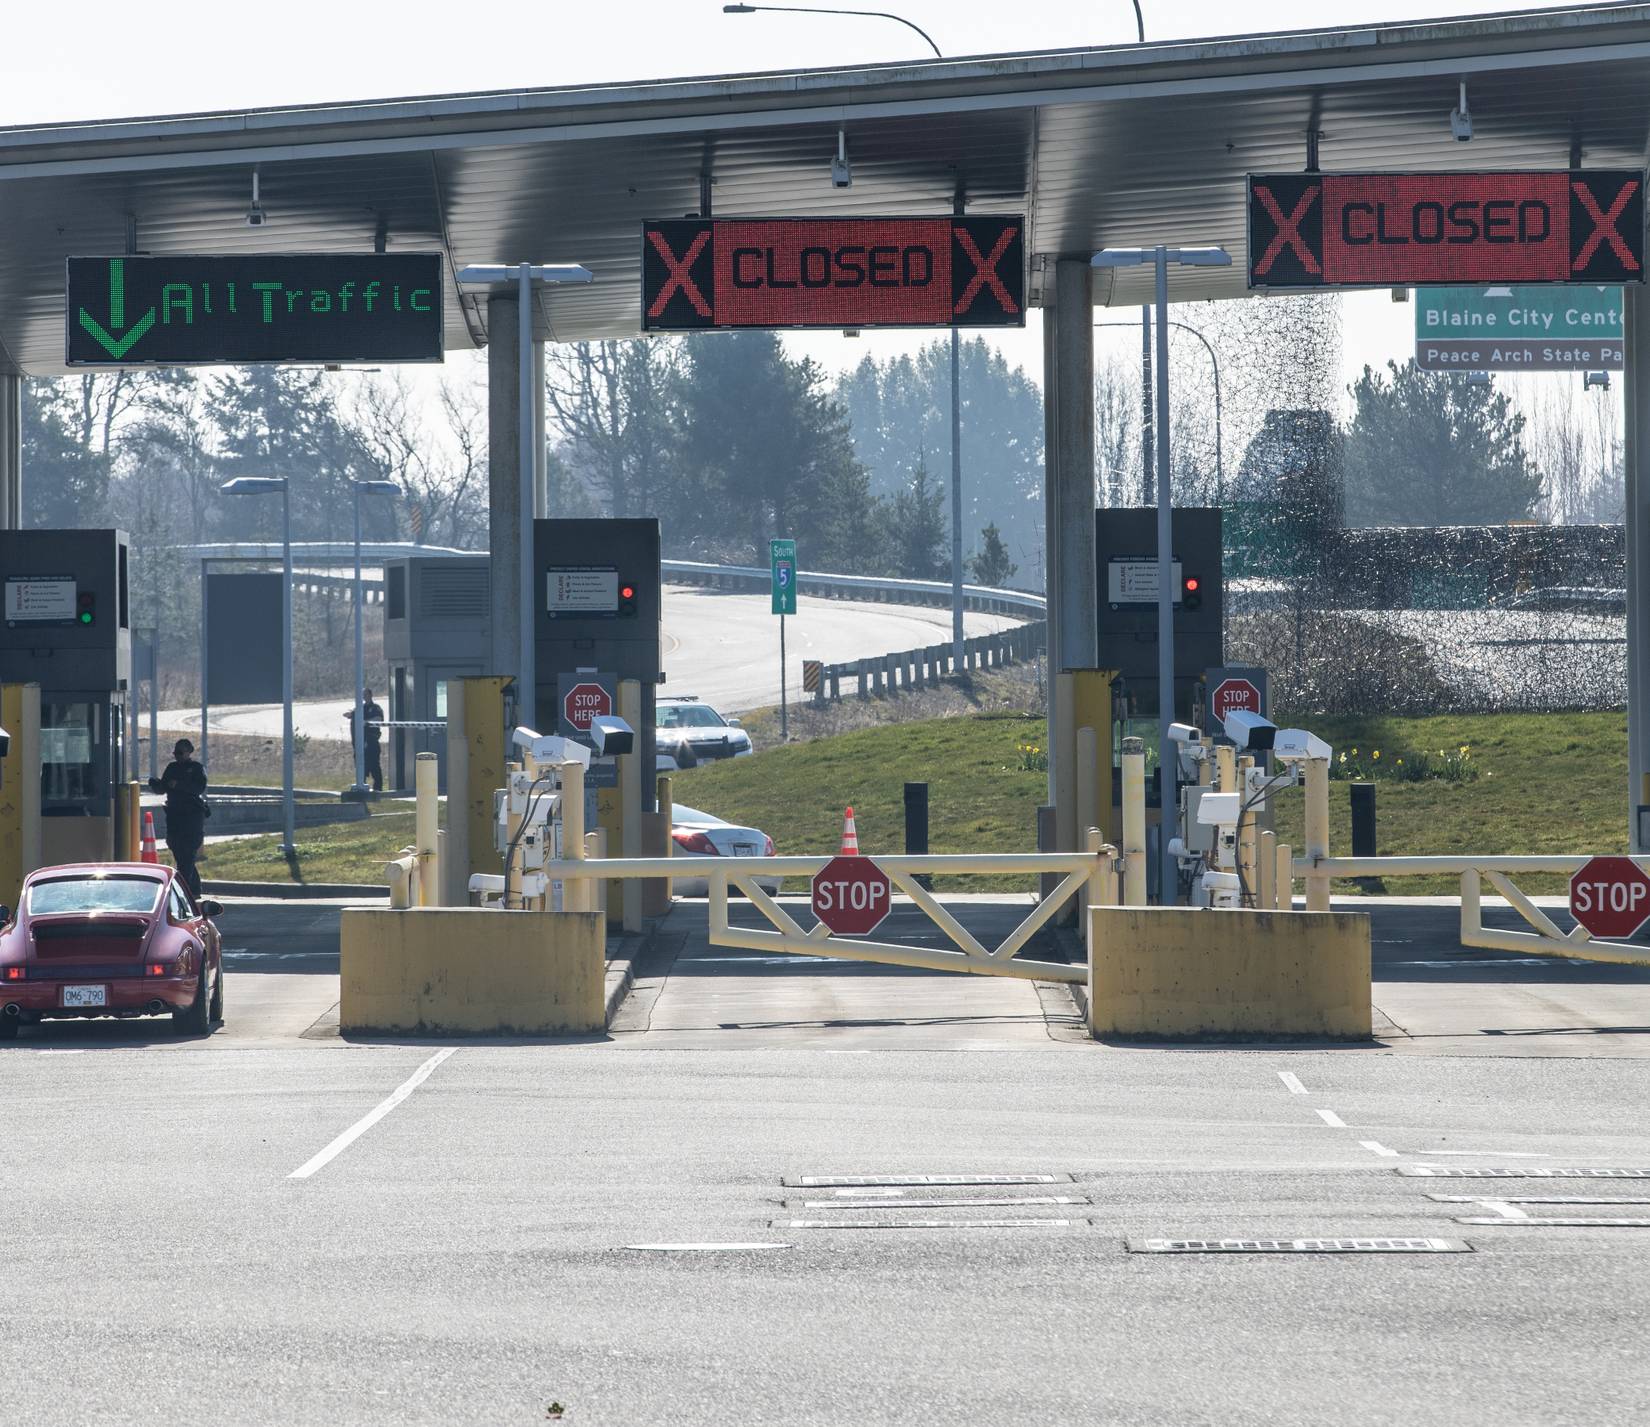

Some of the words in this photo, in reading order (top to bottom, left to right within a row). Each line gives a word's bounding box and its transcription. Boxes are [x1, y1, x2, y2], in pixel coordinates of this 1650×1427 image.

[1342, 200, 1550, 245] CLOSED
[732, 245, 933, 288] CLOSED
[162, 282, 237, 324] All
[252, 281, 431, 323] Traffic
[1426, 309, 1497, 326] Blaine
[1508, 308, 1554, 329] City
[1427, 349, 1480, 362] Peace
[1491, 348, 1533, 362] Arch
[1543, 348, 1591, 361] State
[1600, 348, 1622, 361] Pa
[780, 568, 787, 585] 5
[575, 694, 601, 706] STOP
[1223, 690, 1250, 702] STOP
[817, 881, 885, 910] STOP
[1575, 881, 1647, 912] STOP
